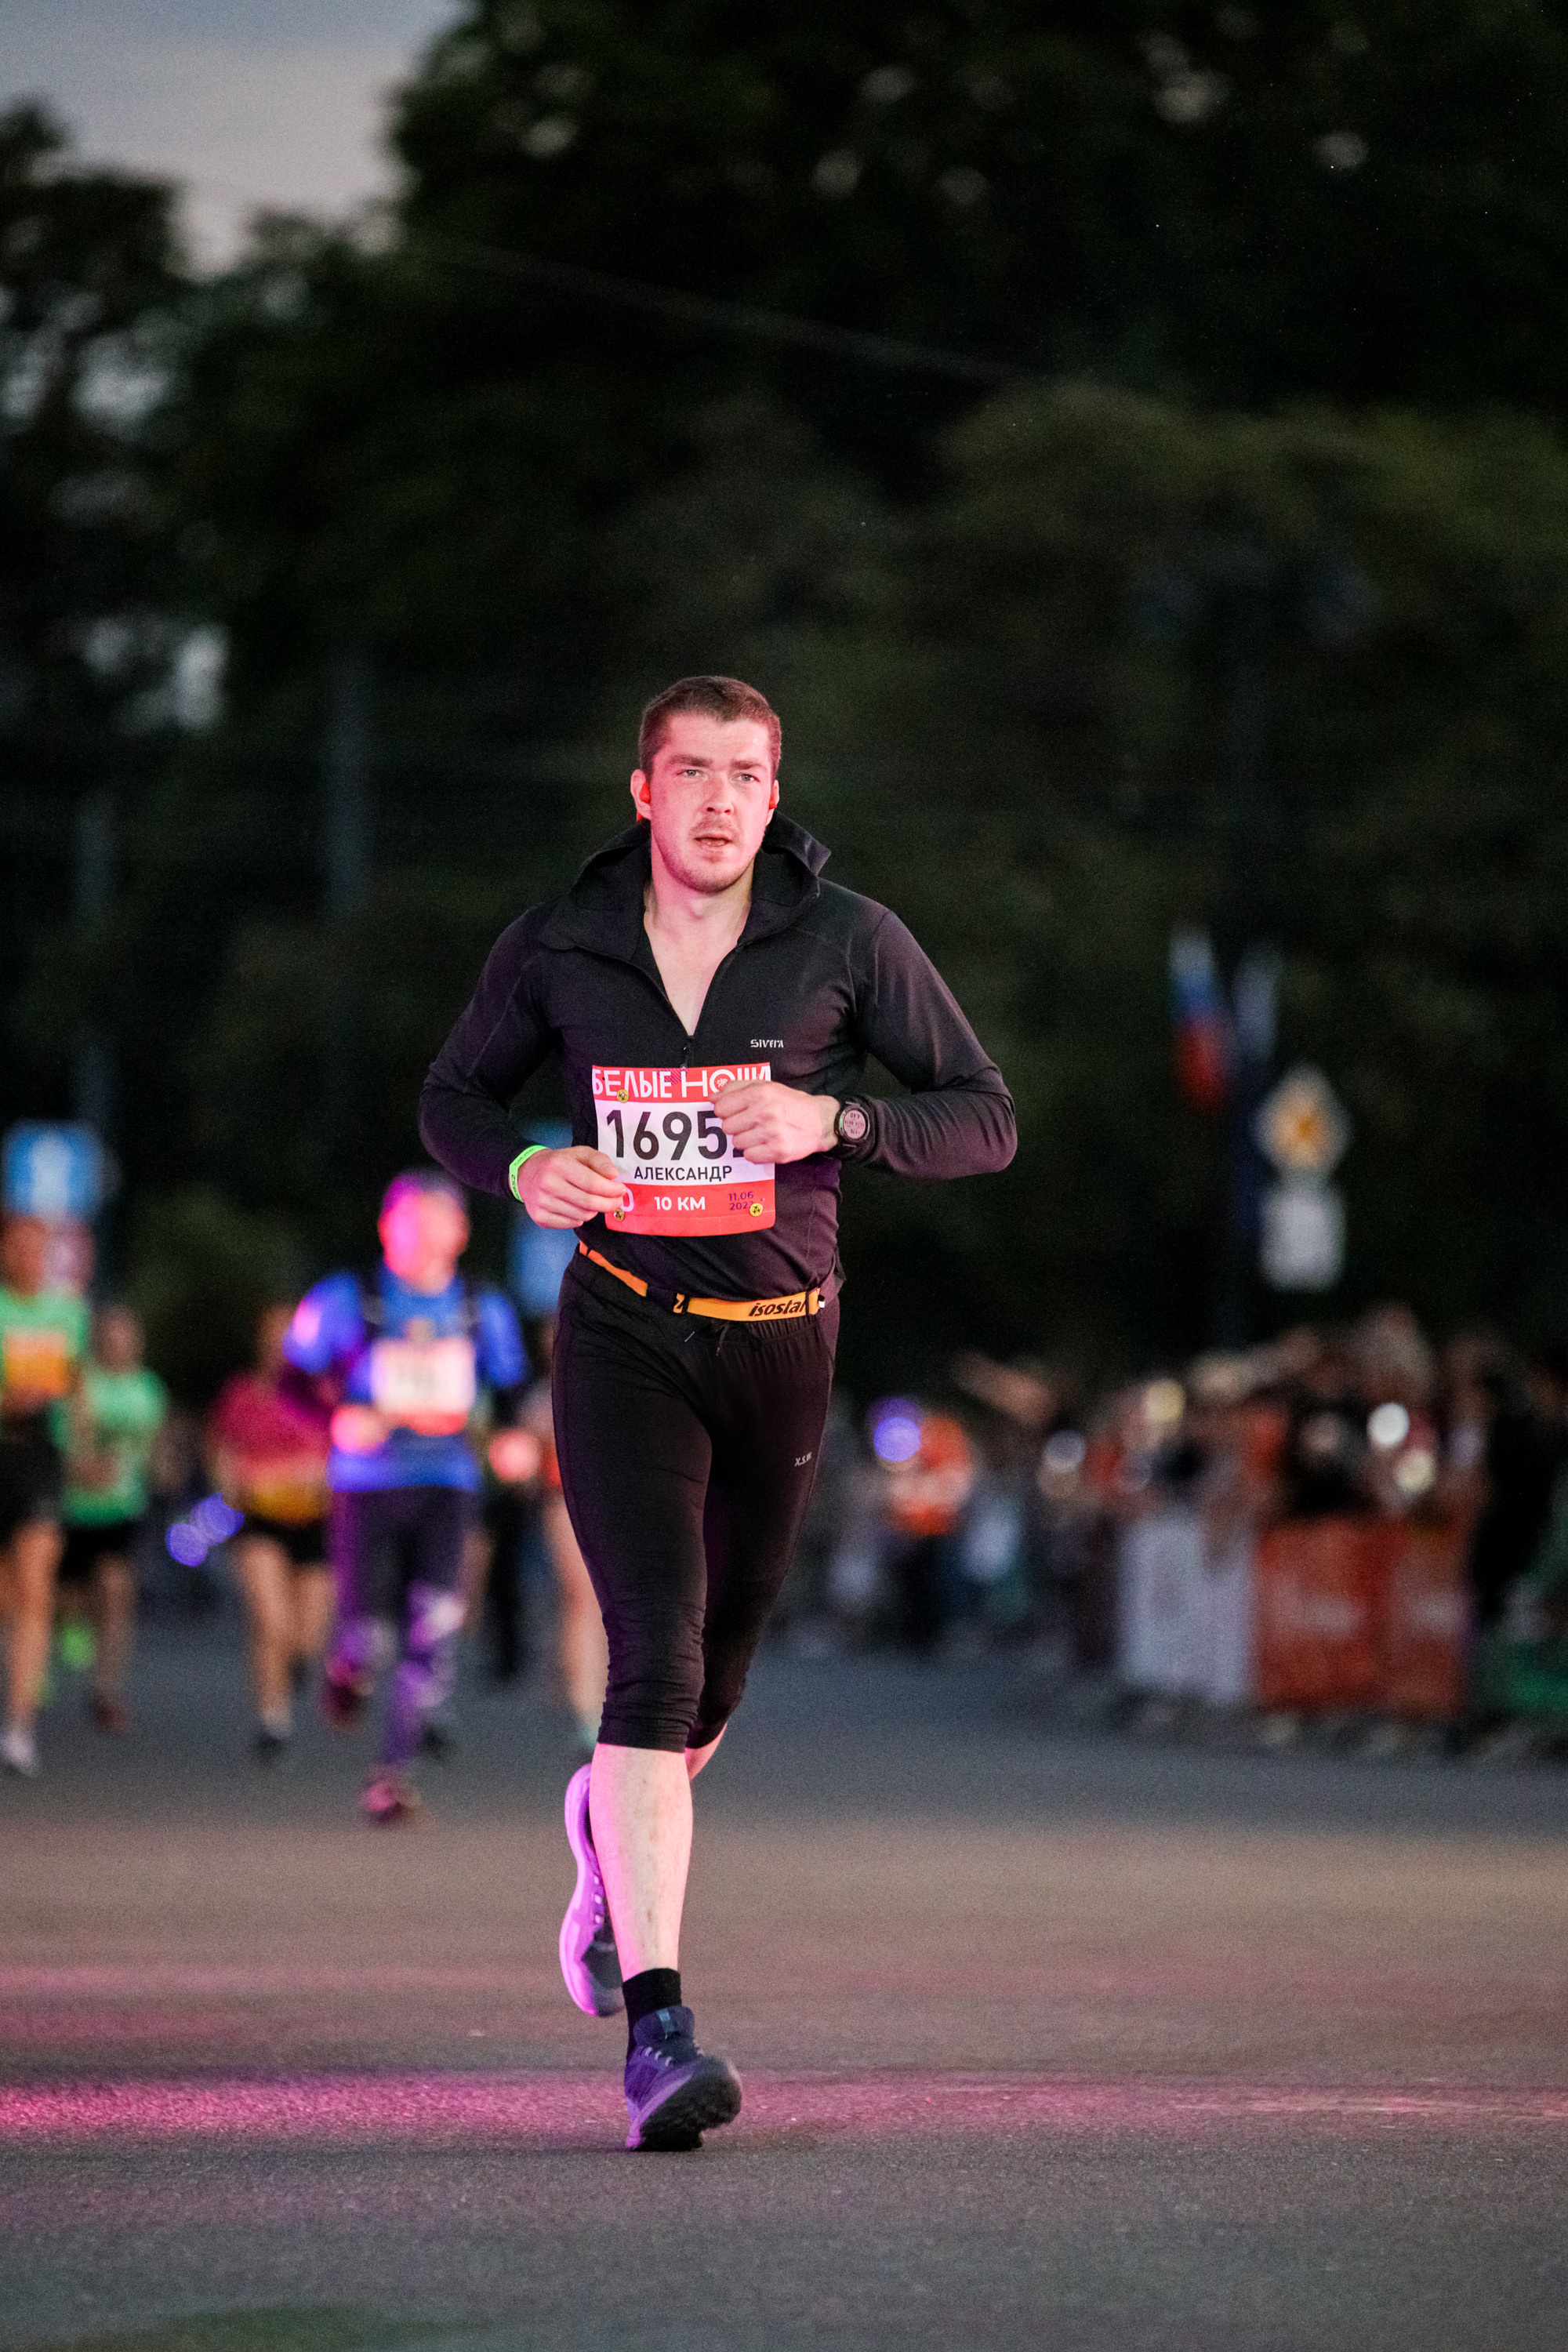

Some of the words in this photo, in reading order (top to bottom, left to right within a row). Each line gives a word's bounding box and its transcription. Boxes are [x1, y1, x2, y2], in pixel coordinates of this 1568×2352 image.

[593, 1069, 672, 1098] БЕЛЫЕ
[606, 1109, 745, 1161] 1695
[634, 1166, 732, 1182] АЛЕКСАНДР
[655, 1196, 672, 1210] 10
[677, 1196, 706, 1210] КМ
[728, 1191, 754, 1201] 11.06
